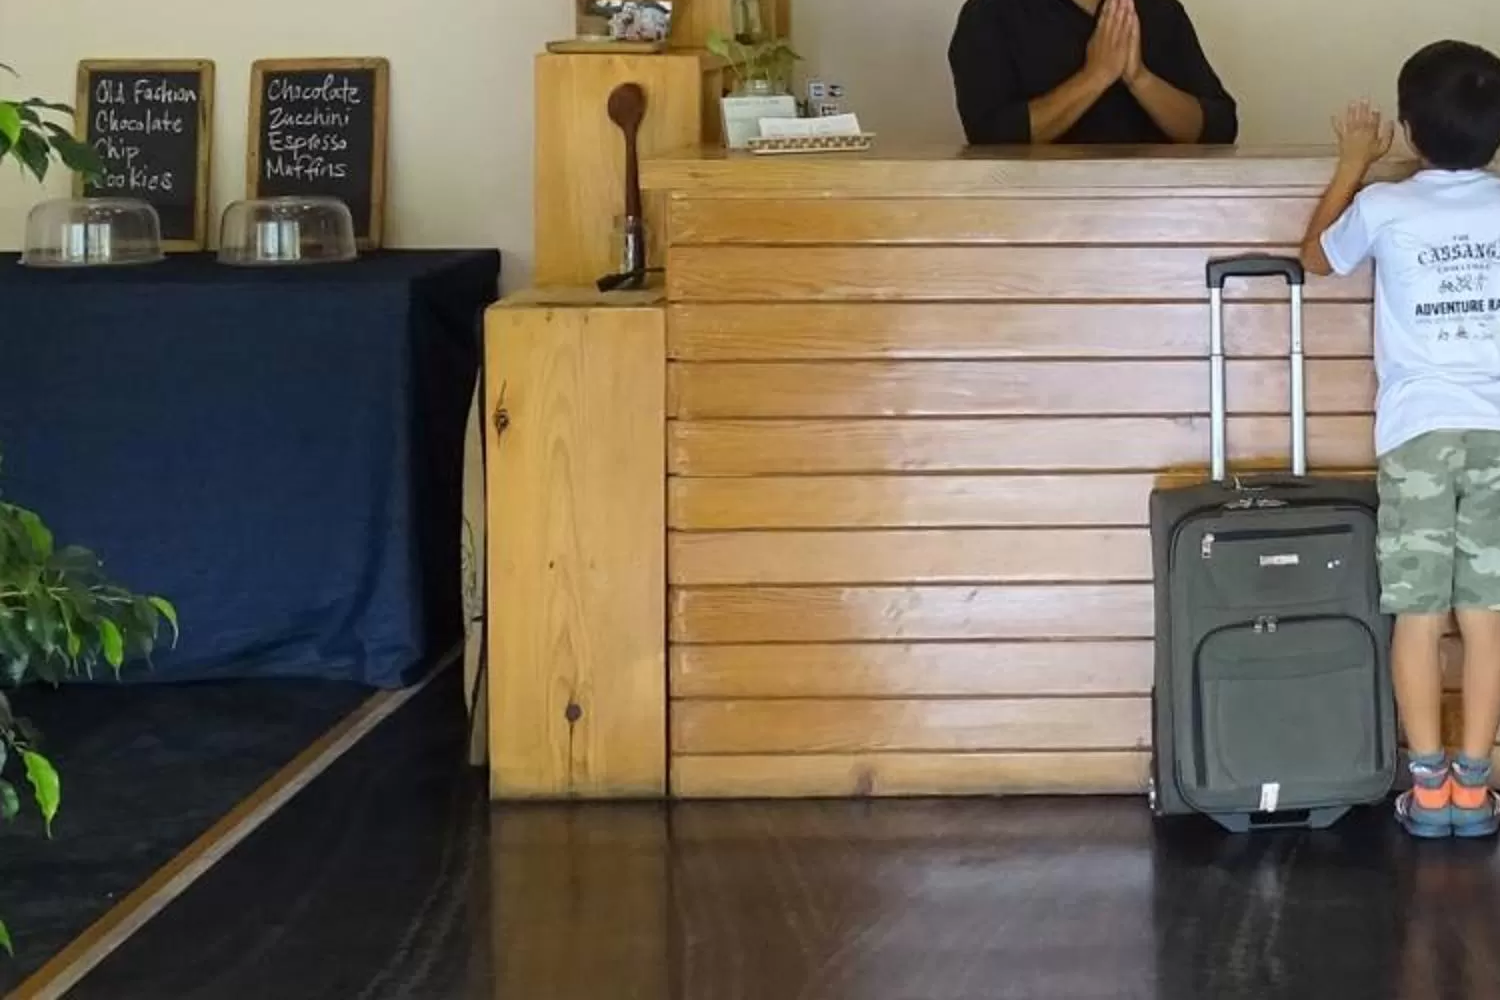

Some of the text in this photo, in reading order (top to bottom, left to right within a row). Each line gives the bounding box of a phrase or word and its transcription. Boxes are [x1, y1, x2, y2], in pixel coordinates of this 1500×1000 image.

[268, 73, 361, 103] Chocolate
[95, 109, 183, 134] Chocolate
[269, 107, 352, 129] Zucchini
[268, 131, 347, 160] Espresso
[266, 154, 348, 182] Muffins
[1415, 299, 1485, 316] ADVENTURE
